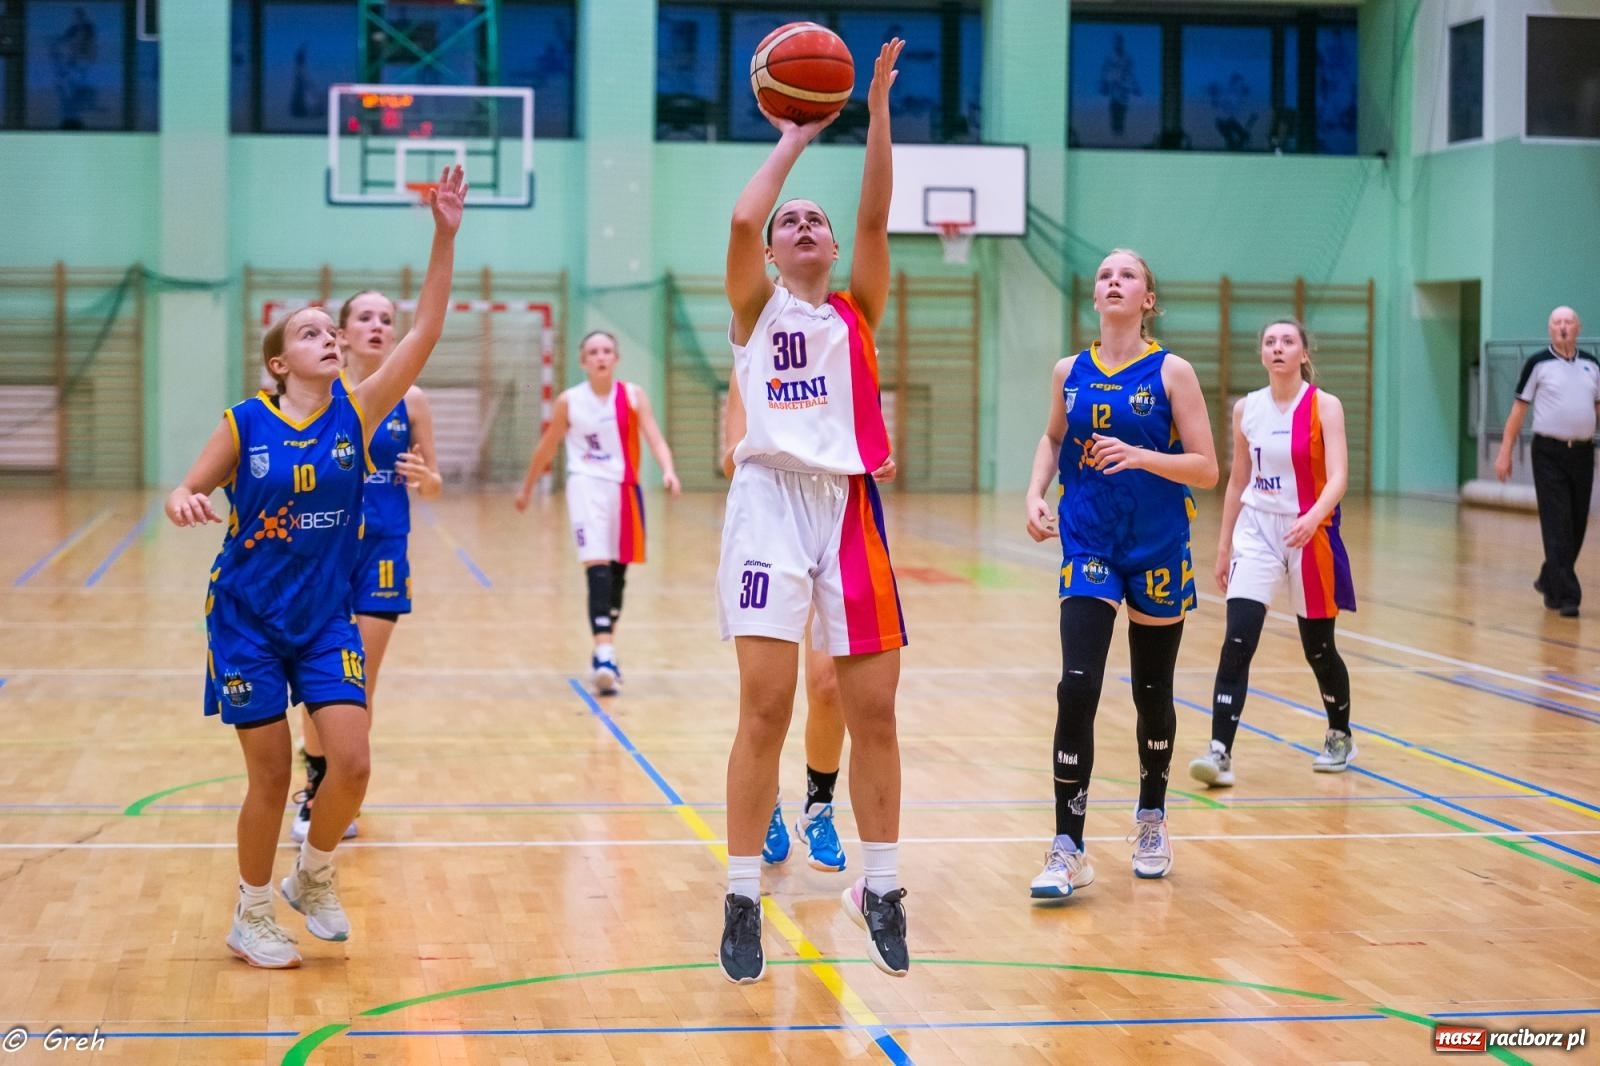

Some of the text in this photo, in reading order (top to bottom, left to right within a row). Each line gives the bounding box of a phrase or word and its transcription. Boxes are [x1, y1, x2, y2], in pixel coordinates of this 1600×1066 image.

[773, 331, 807, 371] 30
[766, 376, 828, 401] MINI
[1090, 383, 1123, 391] regio
[768, 397, 828, 410] BASKETBALL
[1128, 395, 1156, 405] RMKS
[1092, 403, 1112, 429] 12
[293, 464, 316, 493] 10
[379, 559, 394, 589] 11
[1082, 564, 1109, 575] RMKS
[1145, 567, 1171, 597] 12
[740, 570, 769, 609] 30
[1153, 739, 1169, 751] NBA
[1062, 753, 1078, 765] NBA
